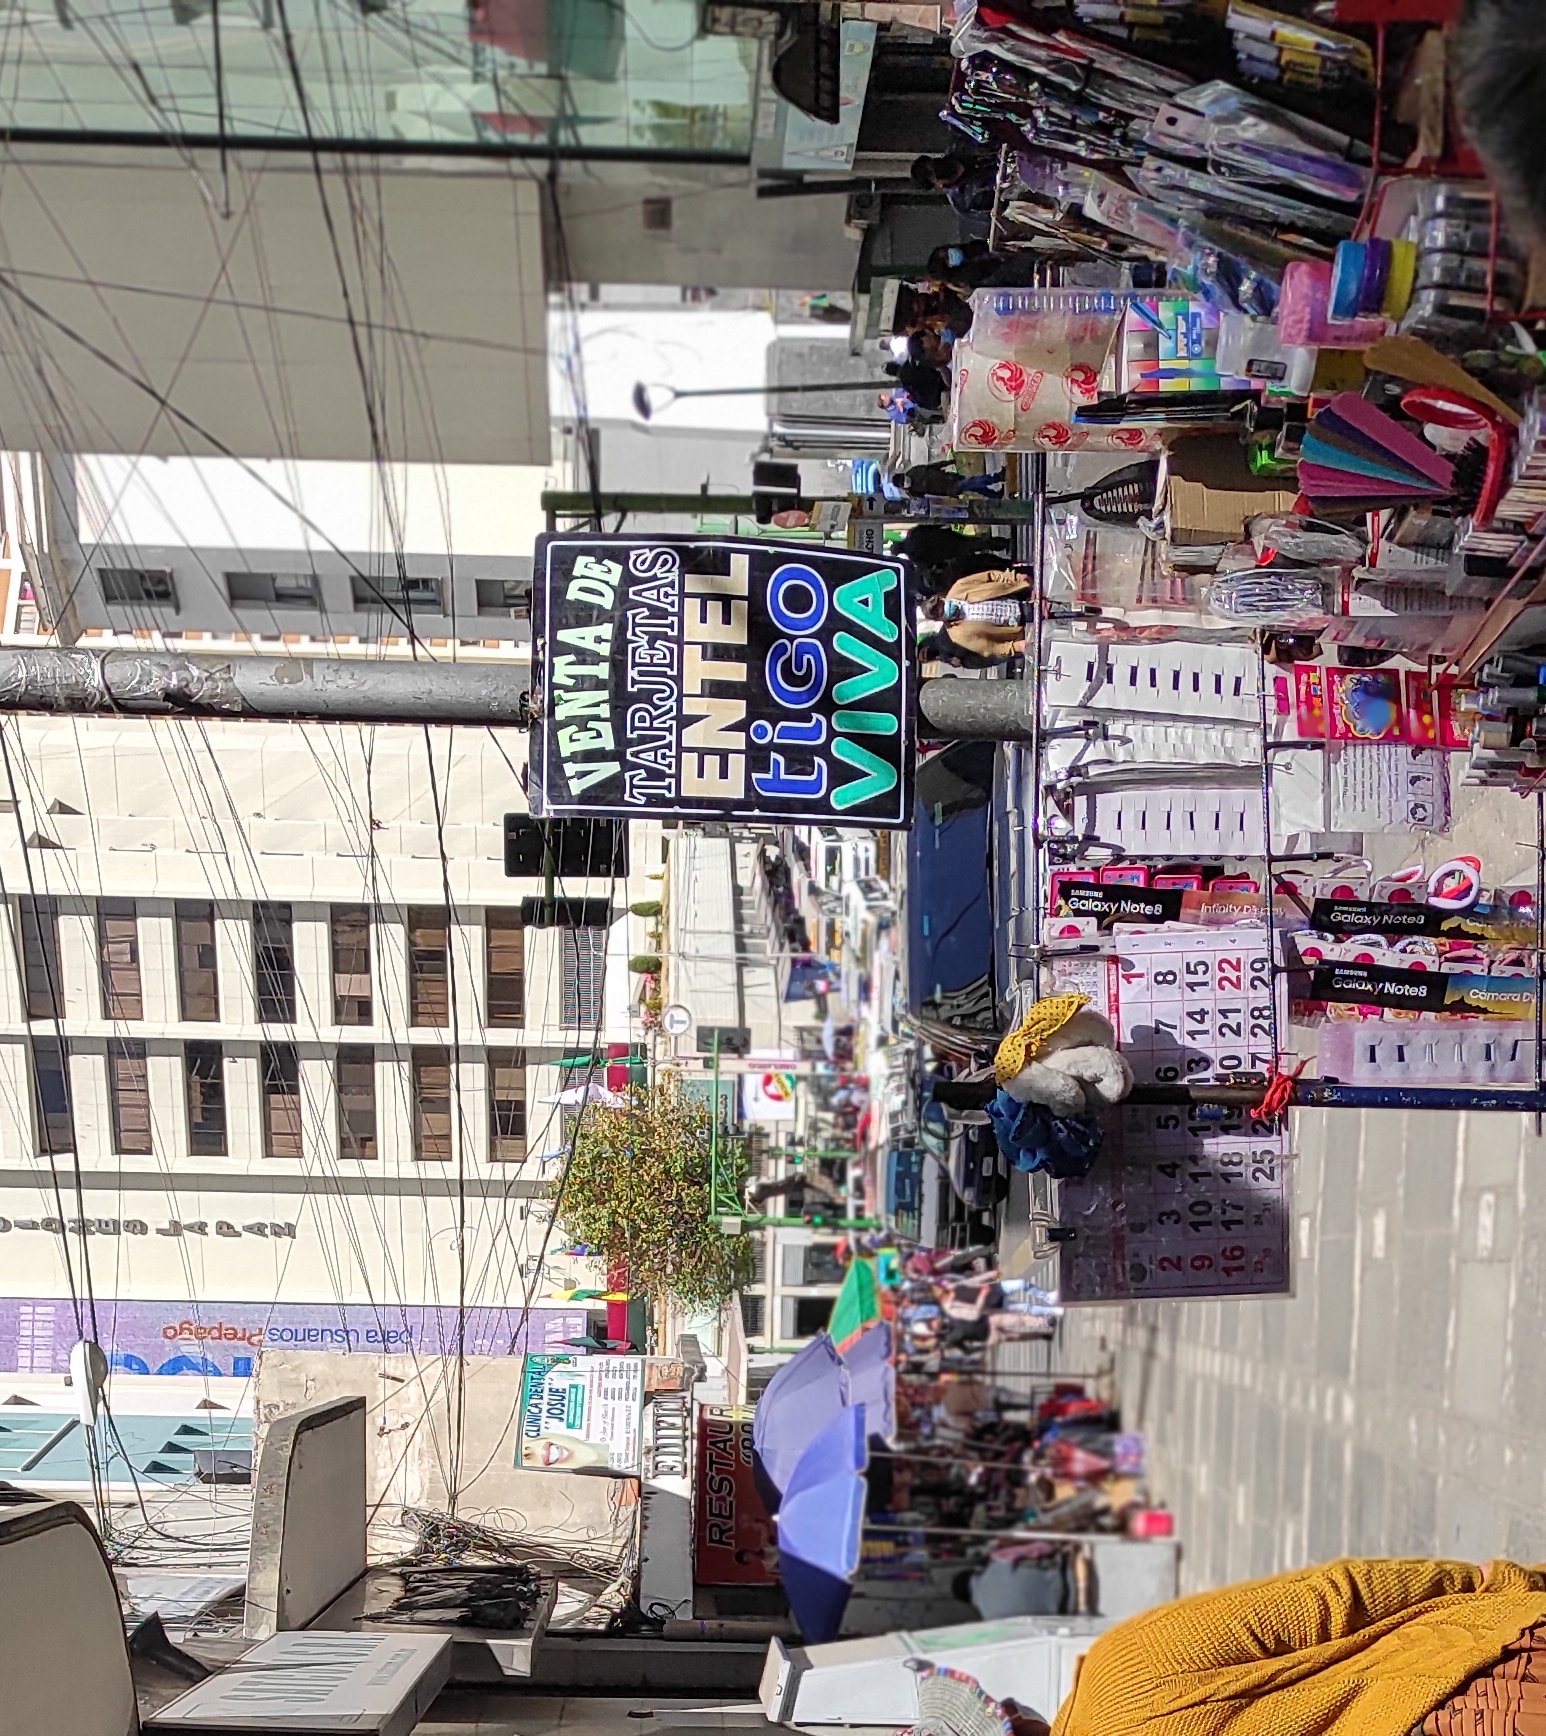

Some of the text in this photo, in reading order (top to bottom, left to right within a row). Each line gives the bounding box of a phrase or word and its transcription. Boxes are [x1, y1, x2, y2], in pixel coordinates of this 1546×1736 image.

[552, 555, 624, 796] VENTA DE
[624, 547, 680, 804] TARJETAS
[681, 552, 750, 799] ENTEL
[830, 567, 900, 810] VIVA
[1067, 896, 1164, 916] Galaxy Note8
[1329, 910, 1426, 927] Galaxy Note8
[1121, 972, 1146, 985] 1
[1153, 969, 1178, 986] 8
[1185, 960, 1210, 993] 15
[1217, 956, 1242, 992] 22
[1249, 957, 1272, 991] 29
[1330, 976, 1429, 997] Galaxy Note8
[1154, 1018, 1178, 1035] 7
[1185, 1007, 1210, 1041] 14
[1217, 1008, 1242, 1039] 21
[1249, 1005, 1273, 1039] 28
[1154, 1066, 1179, 1083] 6
[1186, 1056, 1211, 1085] 13
[1218, 1054, 1242, 1071] 0
[1155, 1114, 1180, 1131] 5
[1156, 1161, 1181, 1179] 4
[1219, 1152, 1244, 1184] 18
[1251, 1149, 1276, 1183] 25
[155, 1220, 209, 1237] LA
[215, 1220, 297, 1240] PAZ
[1157, 1209, 1181, 1226] 3
[1188, 1200, 1213, 1233] 10
[1220, 1198, 1244, 1232] 17
[1158, 1255, 1182, 1272] 2
[1189, 1254, 1213, 1271] 9
[1221, 1244, 1245, 1278] 16
[162, 1320, 415, 1347] para usuarios Prepago
[524, 1365, 546, 1438] CLINICA DENTAL
[706, 1404, 736, 1550] RESTAUR
